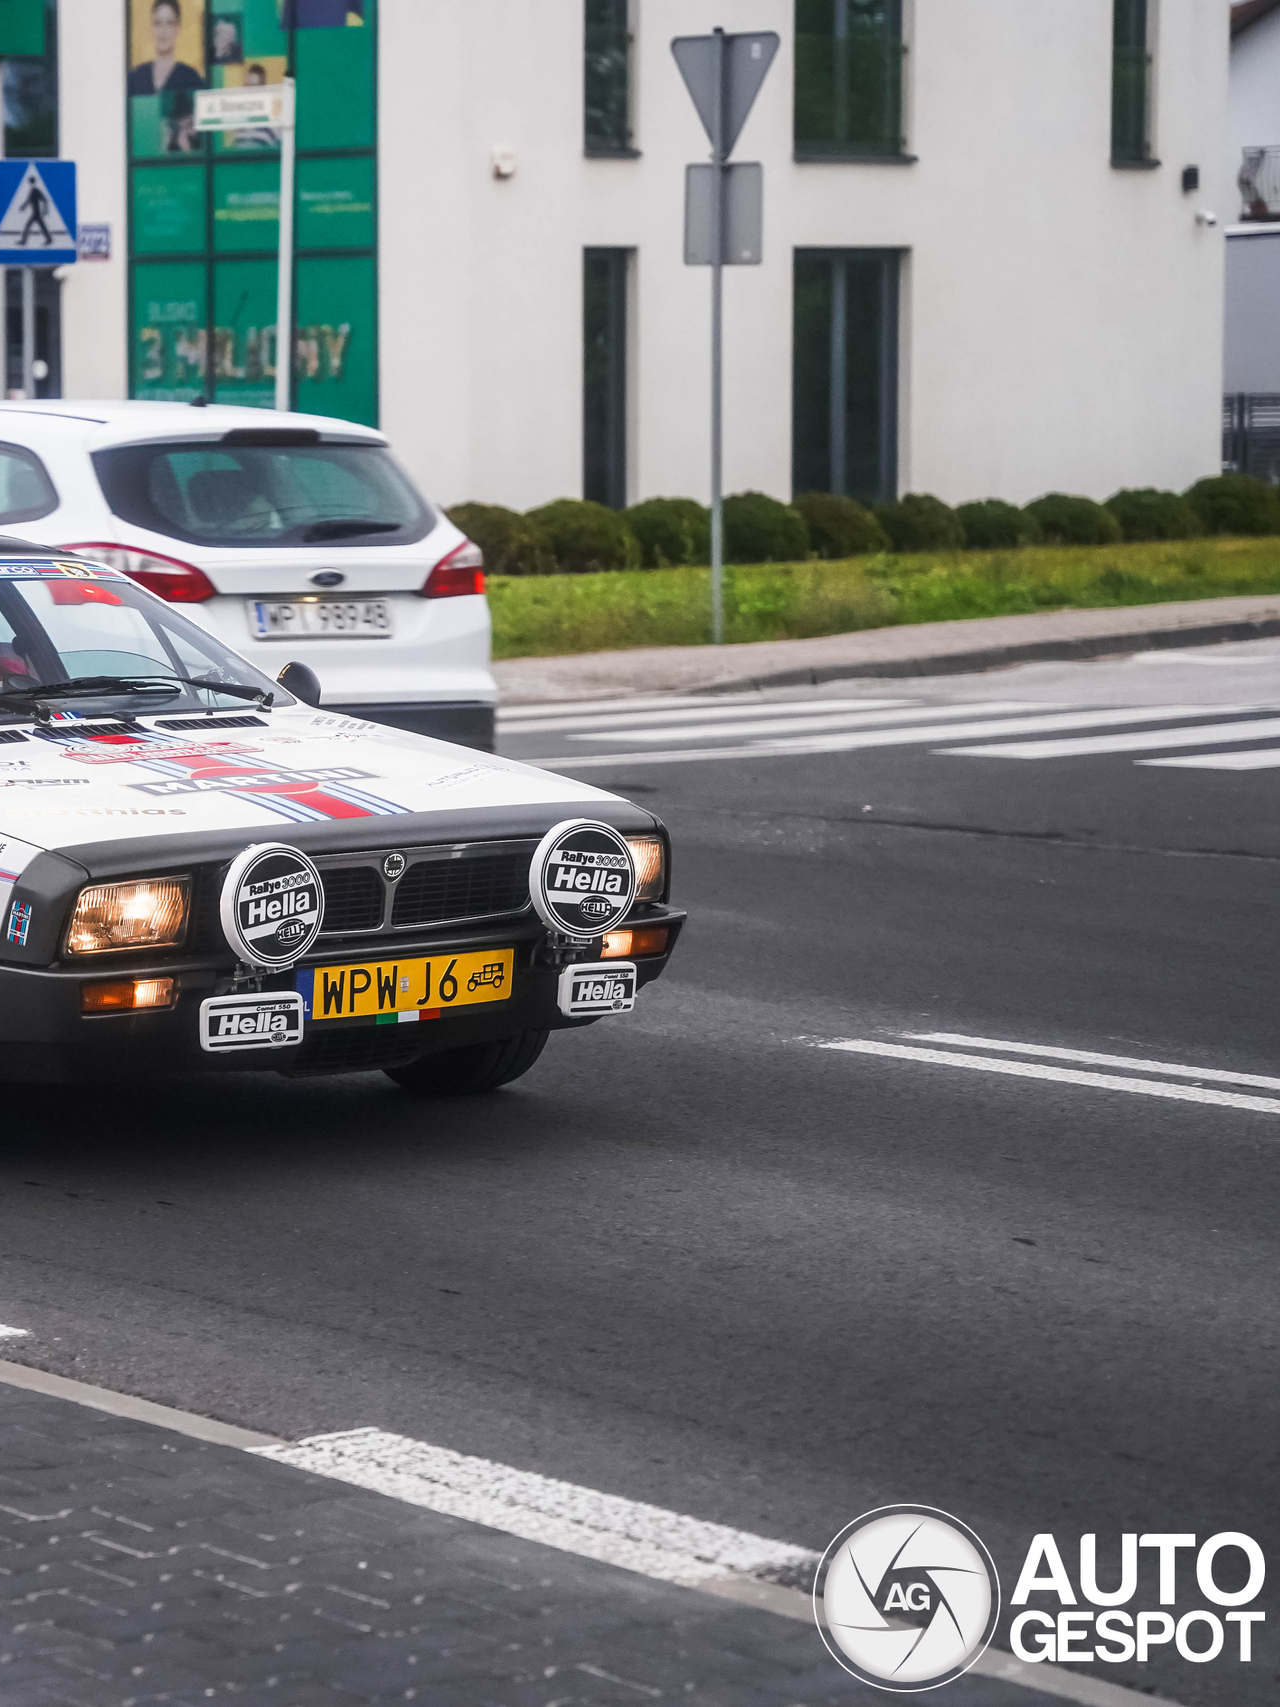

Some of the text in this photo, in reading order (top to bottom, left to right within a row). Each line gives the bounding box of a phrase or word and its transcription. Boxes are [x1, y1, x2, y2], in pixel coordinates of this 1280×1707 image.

[146, 768, 364, 795] MARTINI
[9, 807, 187, 817] matthias
[561, 851, 627, 867] Rallye 3000
[249, 872, 311, 896] Rallye 3000
[554, 866, 622, 893] Hella
[248, 891, 310, 925] Hella
[581, 902, 611, 916] HELLA
[277, 923, 306, 940] HELLA
[323, 958, 458, 1015] WPW J6
[577, 980, 626, 1001] Hella
[218, 1012, 288, 1035] Hella
